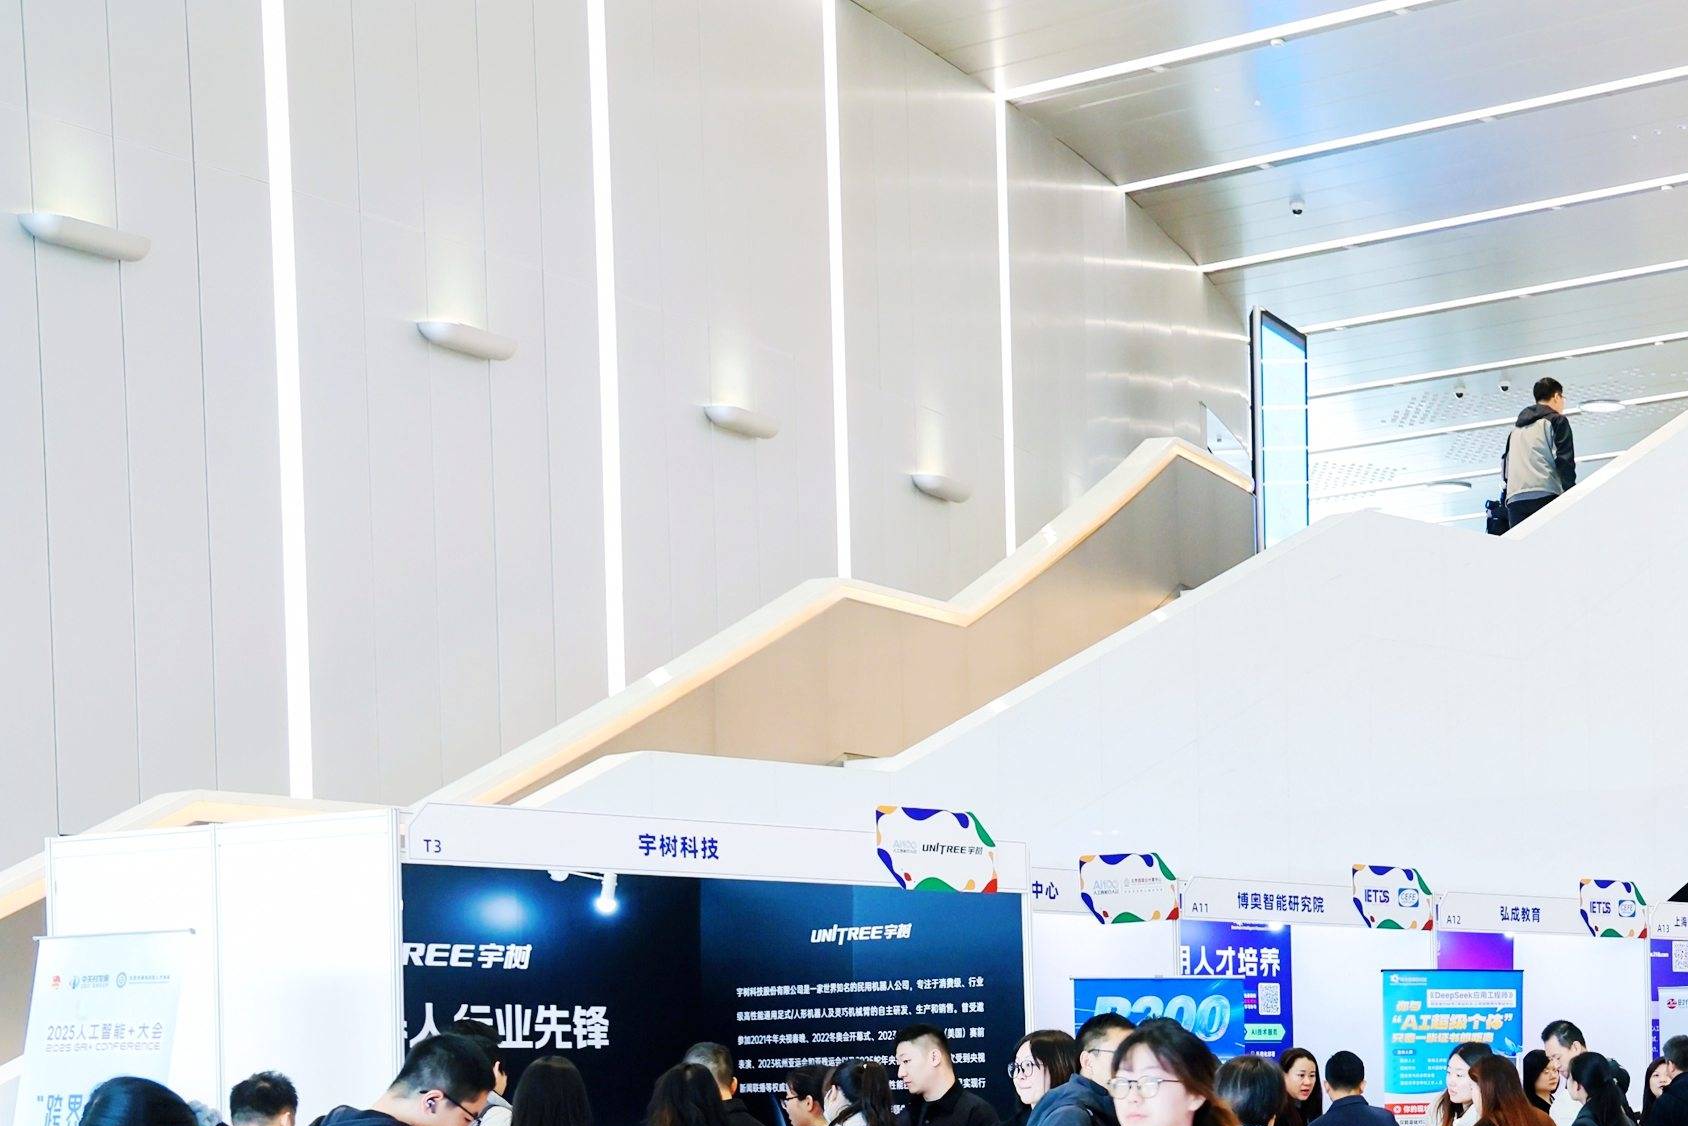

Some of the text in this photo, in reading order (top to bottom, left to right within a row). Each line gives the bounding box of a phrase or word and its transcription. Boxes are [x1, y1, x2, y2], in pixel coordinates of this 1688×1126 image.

[423, 839, 442, 853] T3
[638, 833, 719, 860] 宇树科技
[1032, 880, 1059, 900] 中心
[1192, 902, 1209, 913] A11
[1237, 891, 1325, 914] 博奥智能研究院
[1446, 915, 1461, 925] A12
[1500, 906, 1541, 923] 弘成教育
[1657, 923, 1670, 933] A13
[47, 1022, 163, 1041] 2025人工智能+大会
[403, 1002, 610, 1050] 人行业先锋
